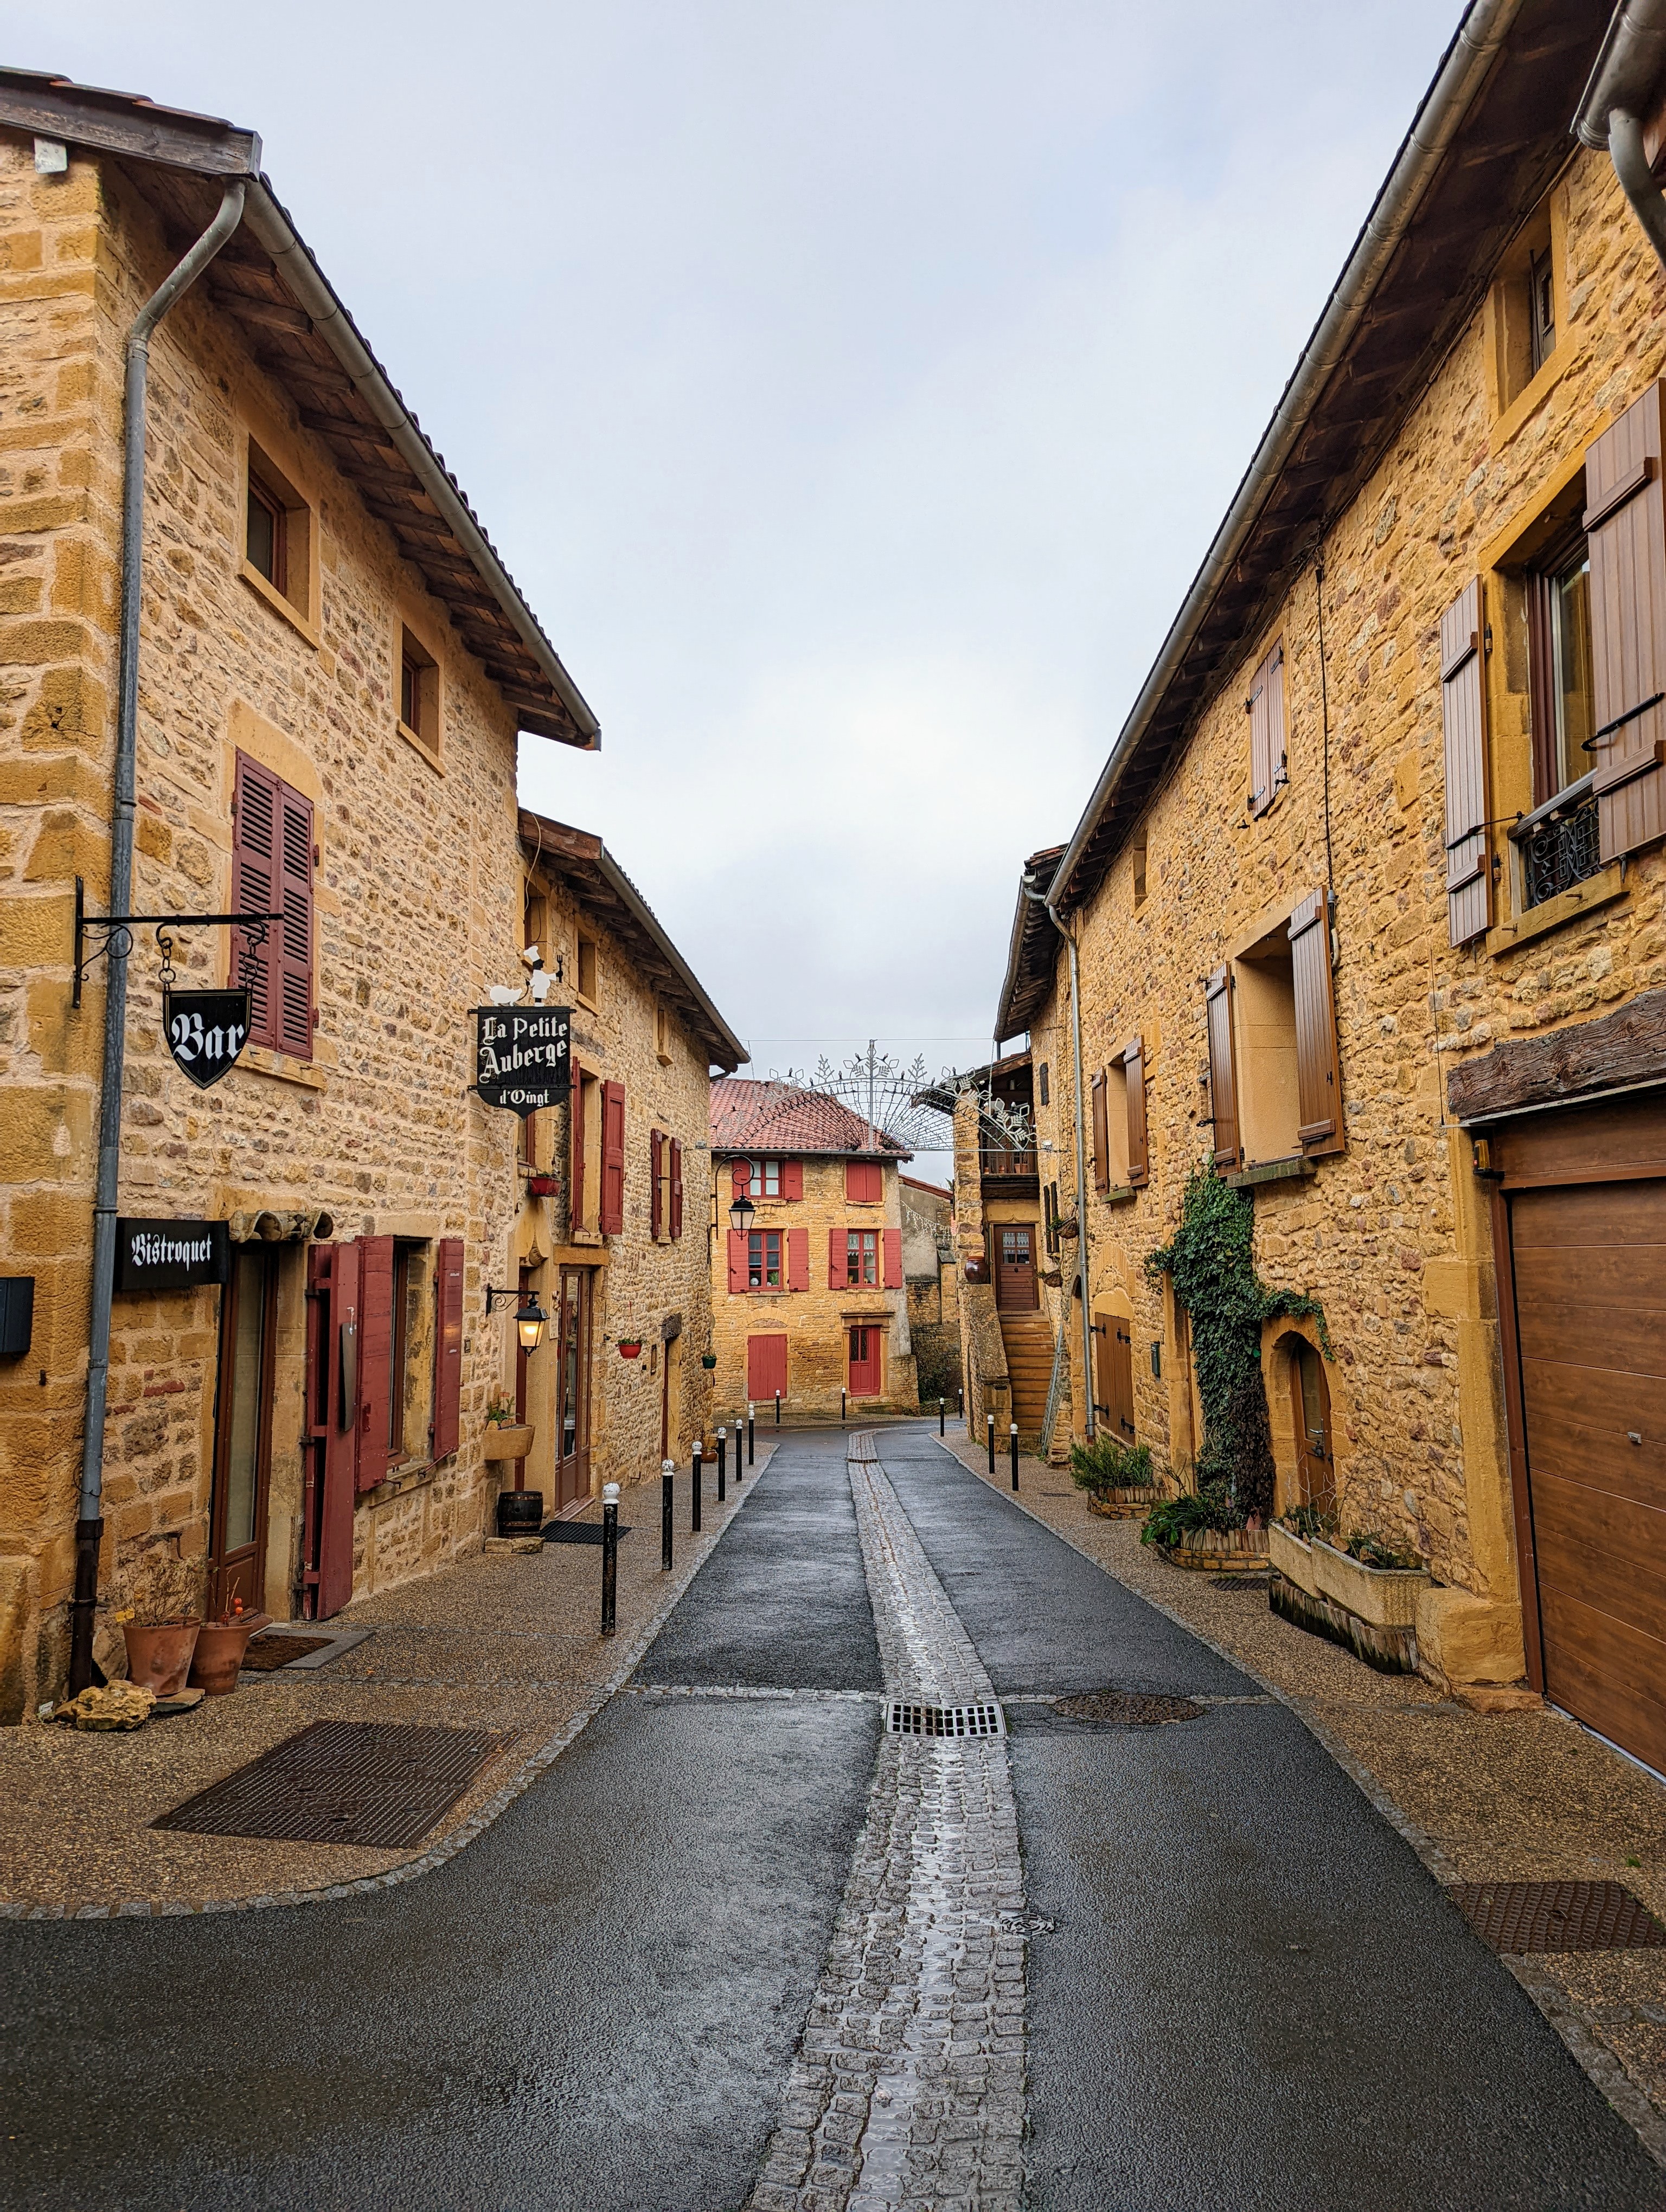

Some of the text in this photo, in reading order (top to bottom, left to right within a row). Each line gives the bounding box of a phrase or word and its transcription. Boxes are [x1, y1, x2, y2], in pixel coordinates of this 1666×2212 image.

[171, 1013, 245, 1061] Bar
[482, 1016, 568, 1046] La Petite
[479, 1040, 568, 1084] Auberge
[499, 1089, 550, 1107] d'Oingt
[131, 1232, 212, 1272] Bistroquet
